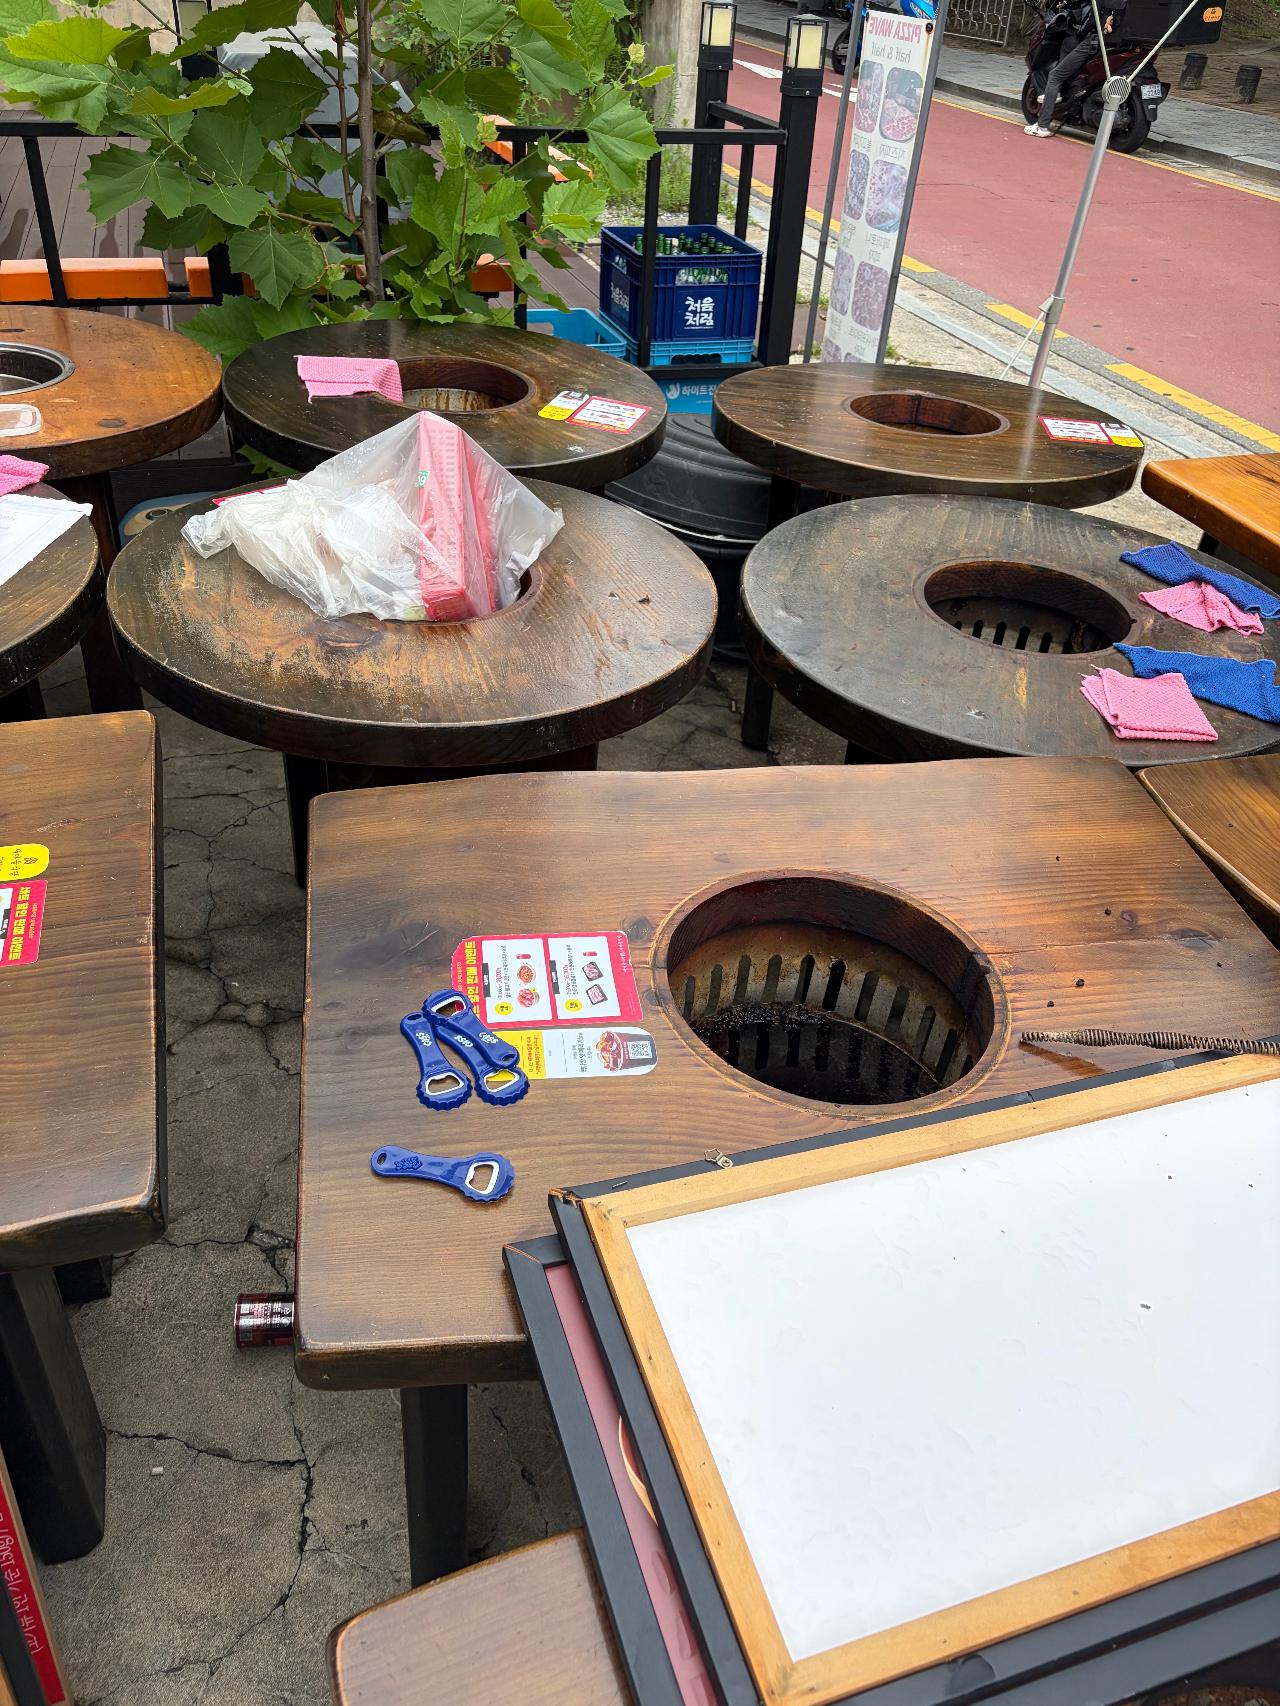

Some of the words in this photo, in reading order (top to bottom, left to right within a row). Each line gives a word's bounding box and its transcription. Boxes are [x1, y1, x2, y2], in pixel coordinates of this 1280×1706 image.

[684, 296, 715, 313] 처음
[684, 311, 714, 326] 처럼
[8, 936, 24, 961] 이벤트
[464, 941, 477, 965] 이벤트
